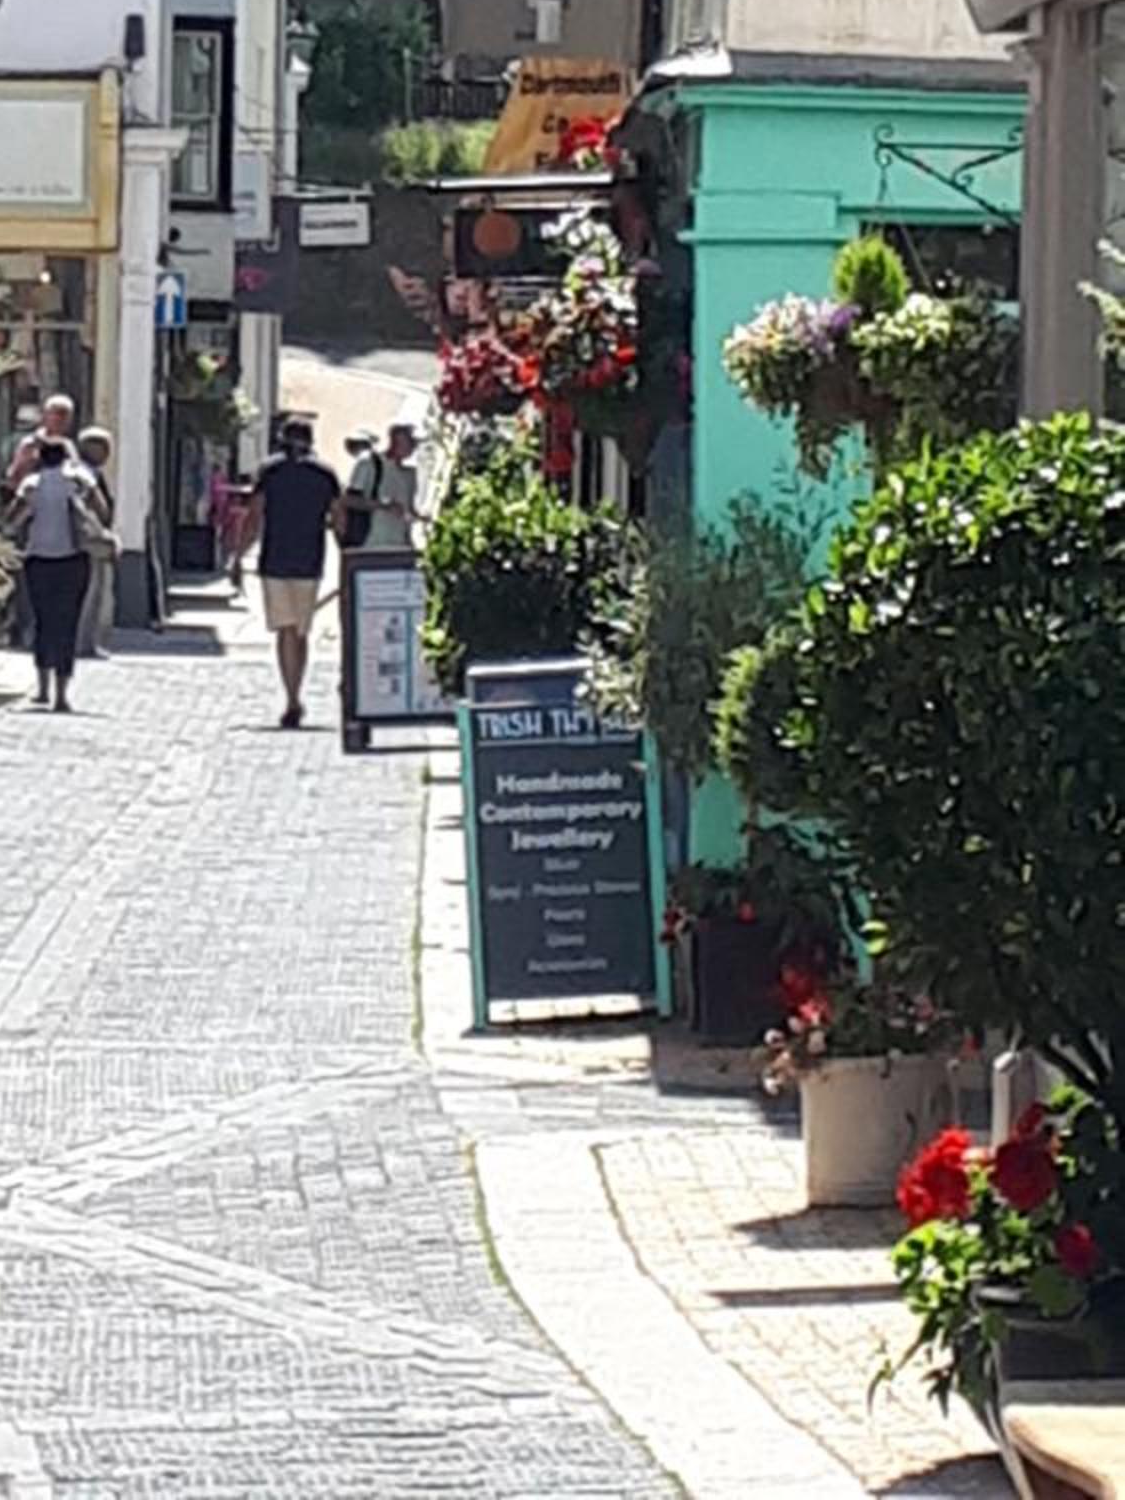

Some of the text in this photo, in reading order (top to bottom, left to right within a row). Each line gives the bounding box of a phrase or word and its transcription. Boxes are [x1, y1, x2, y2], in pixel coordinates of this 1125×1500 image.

[495, 769, 624, 795] Handmade
[478, 801, 643, 824] Contemporary
[510, 826, 615, 852] Jewellery
